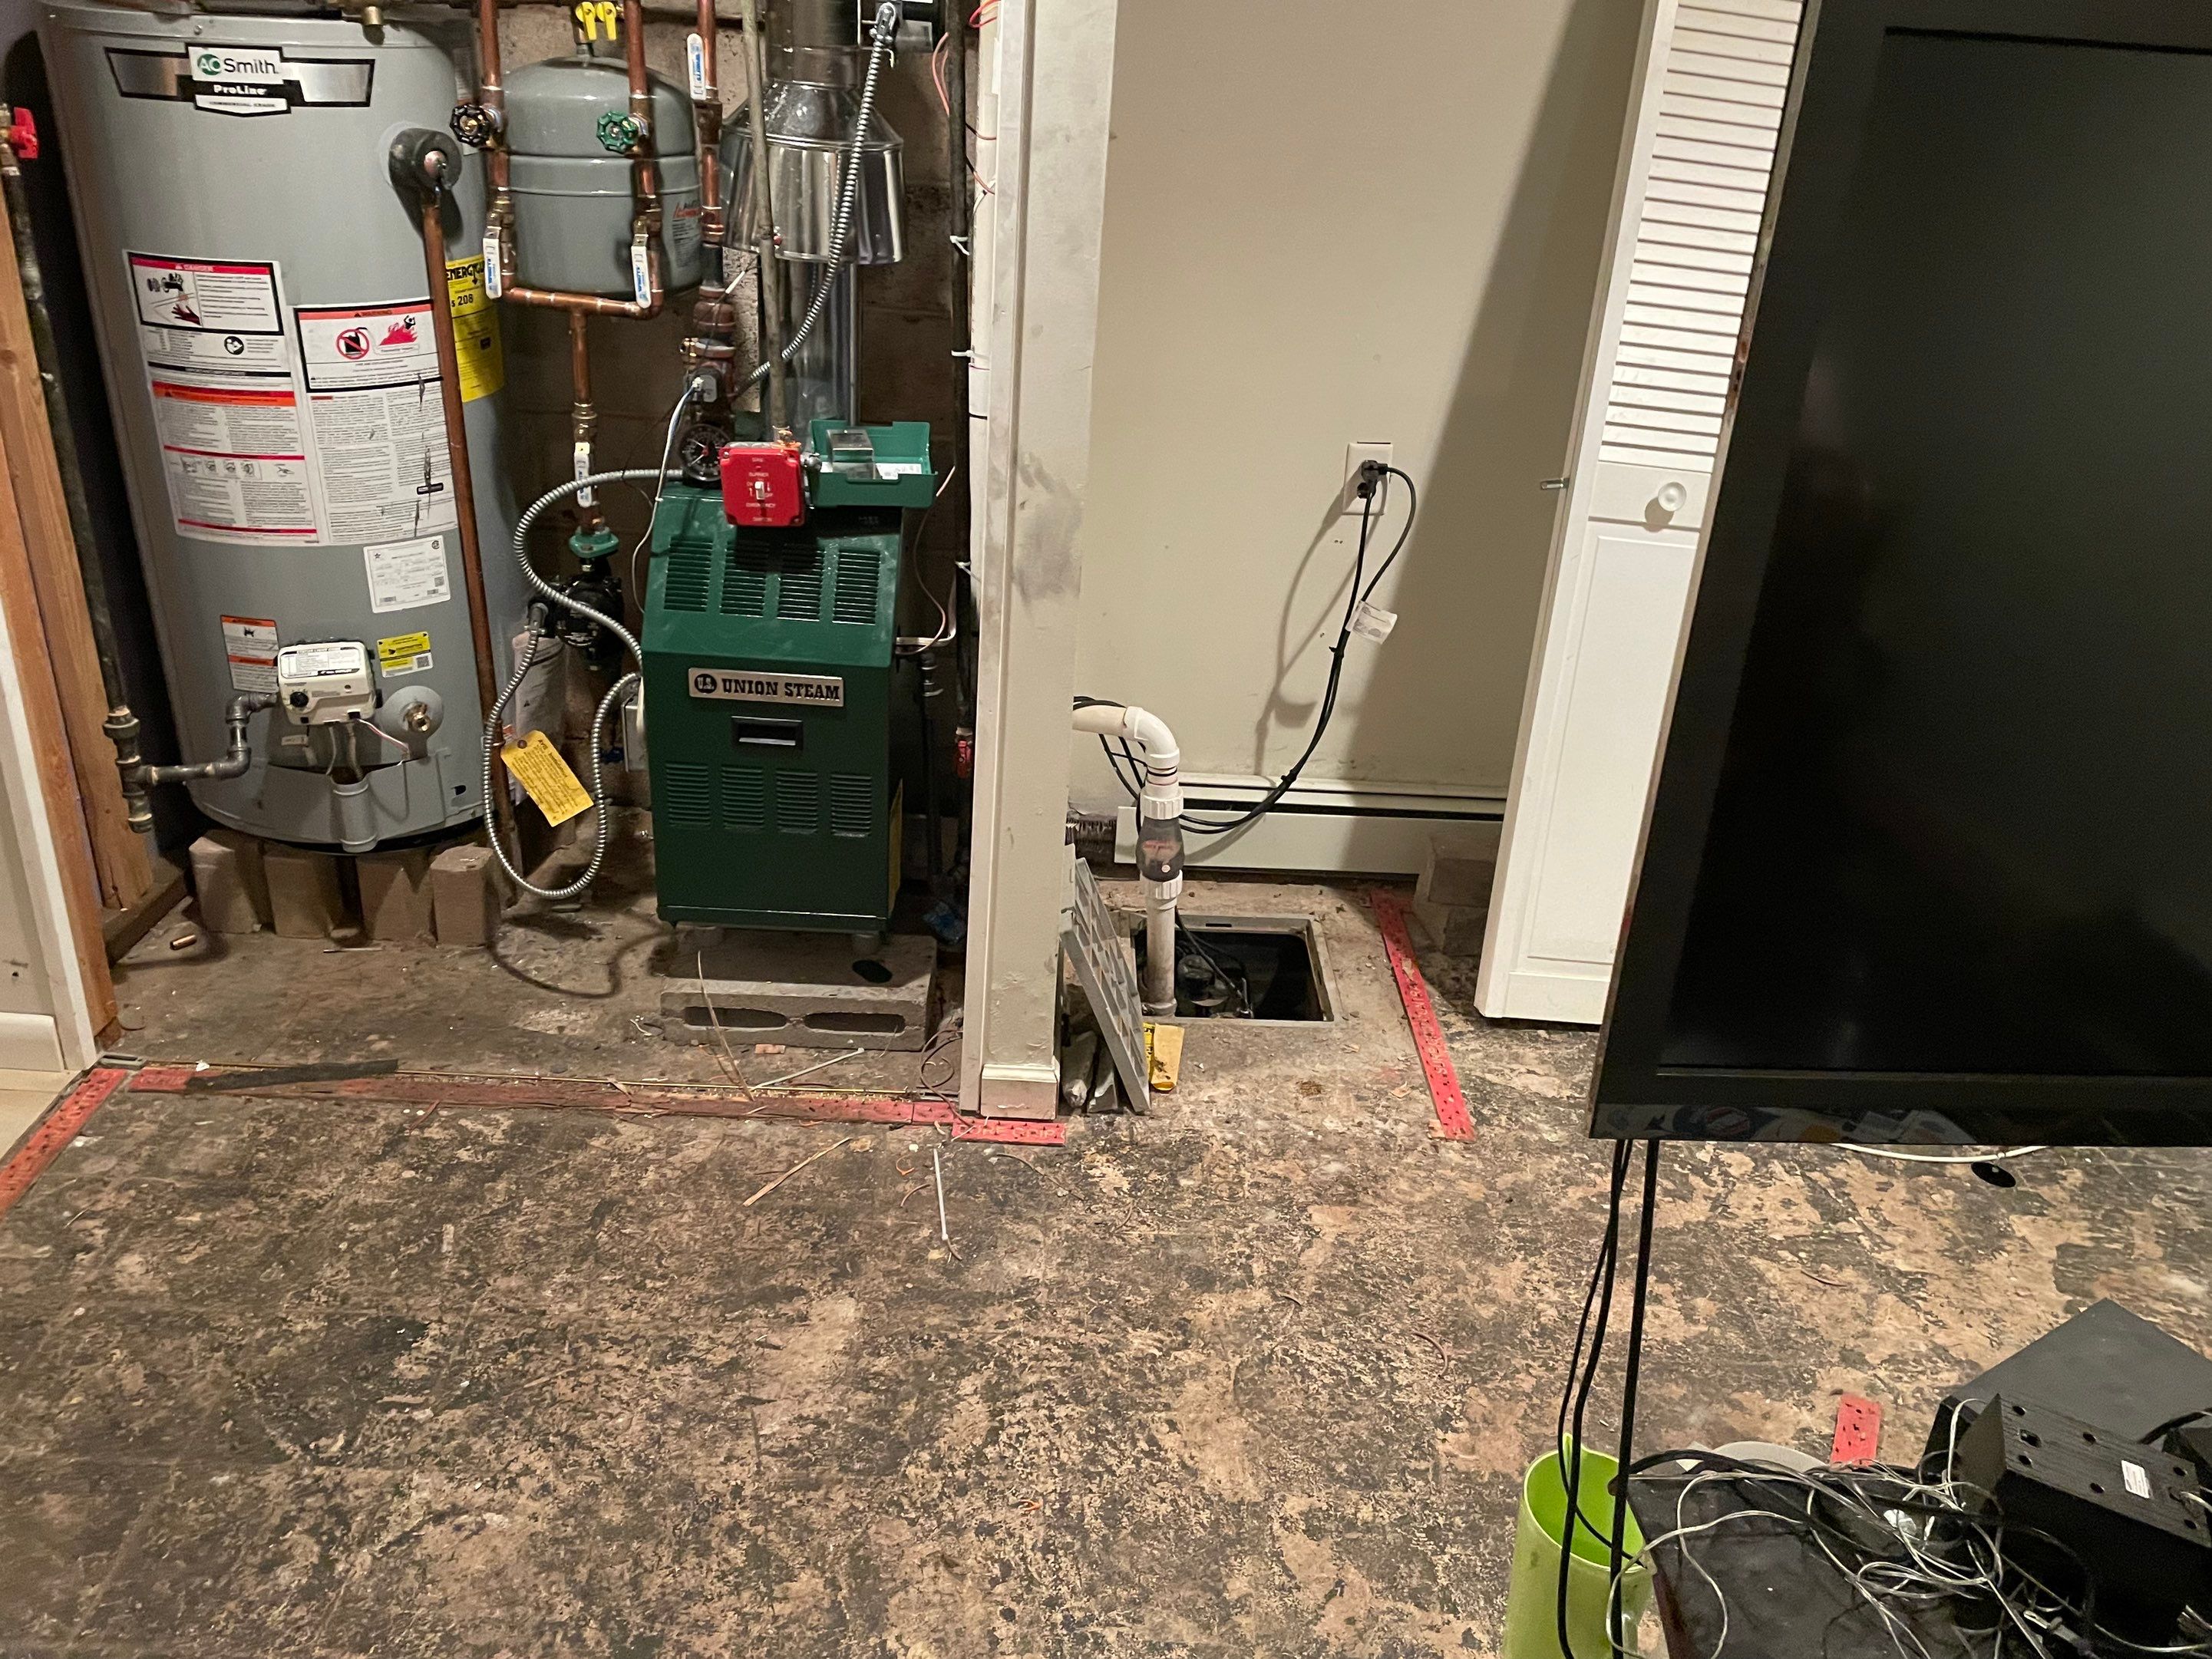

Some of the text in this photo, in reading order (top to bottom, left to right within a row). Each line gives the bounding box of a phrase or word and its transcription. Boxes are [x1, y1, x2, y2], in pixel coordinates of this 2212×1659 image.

[223, 58, 277, 74] Smith
[213, 84, 268, 95] ProLine
[721, 678, 841, 701] UNION STEAM
